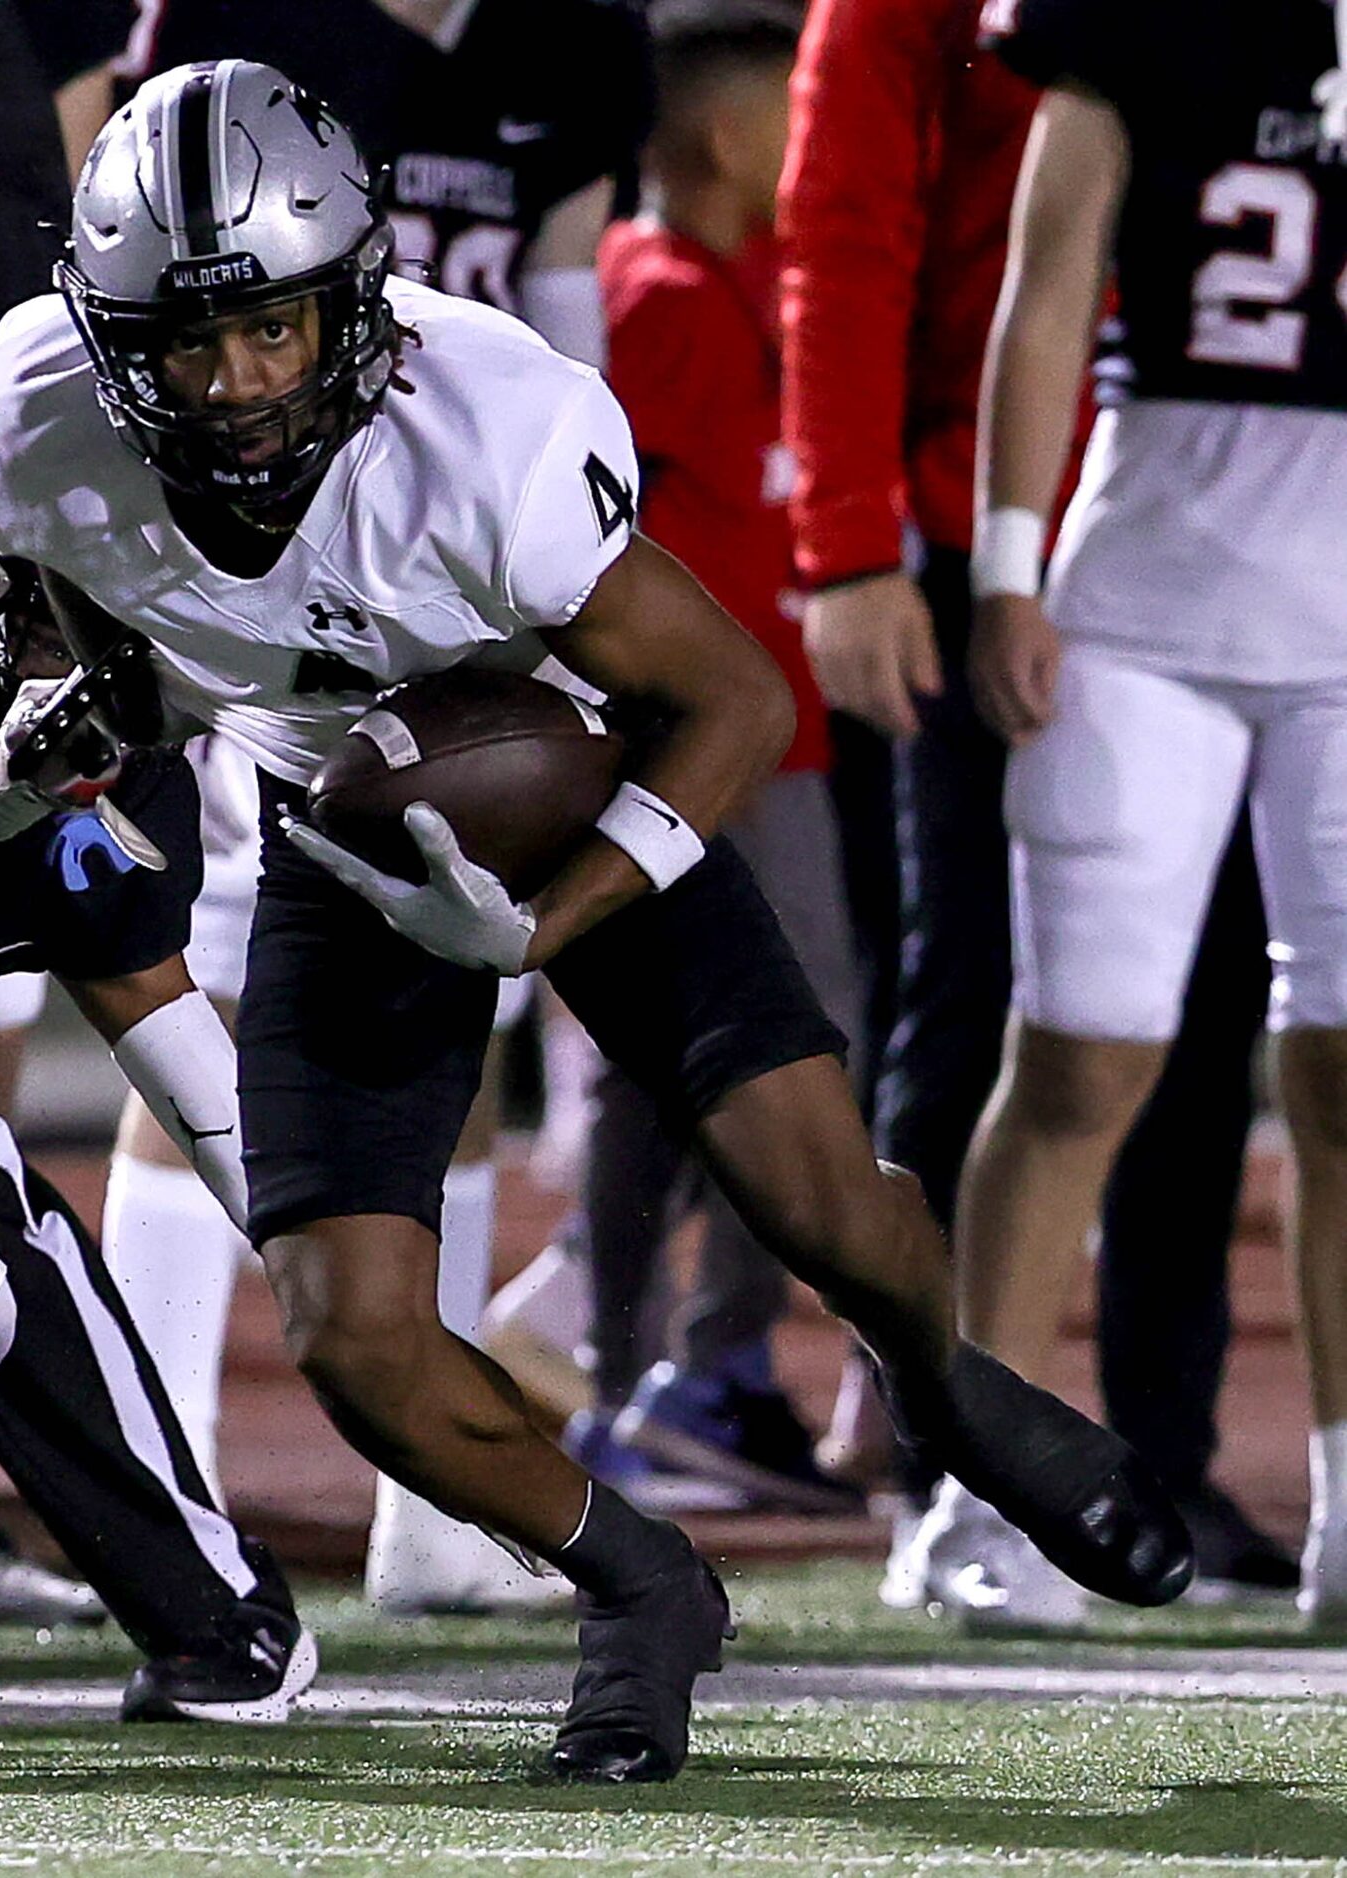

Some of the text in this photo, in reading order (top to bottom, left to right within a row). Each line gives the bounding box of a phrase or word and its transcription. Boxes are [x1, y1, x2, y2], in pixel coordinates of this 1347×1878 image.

[173, 259, 253, 288] WILDCATS
[1185, 160, 1347, 370] 2
[578, 450, 635, 547] 4
